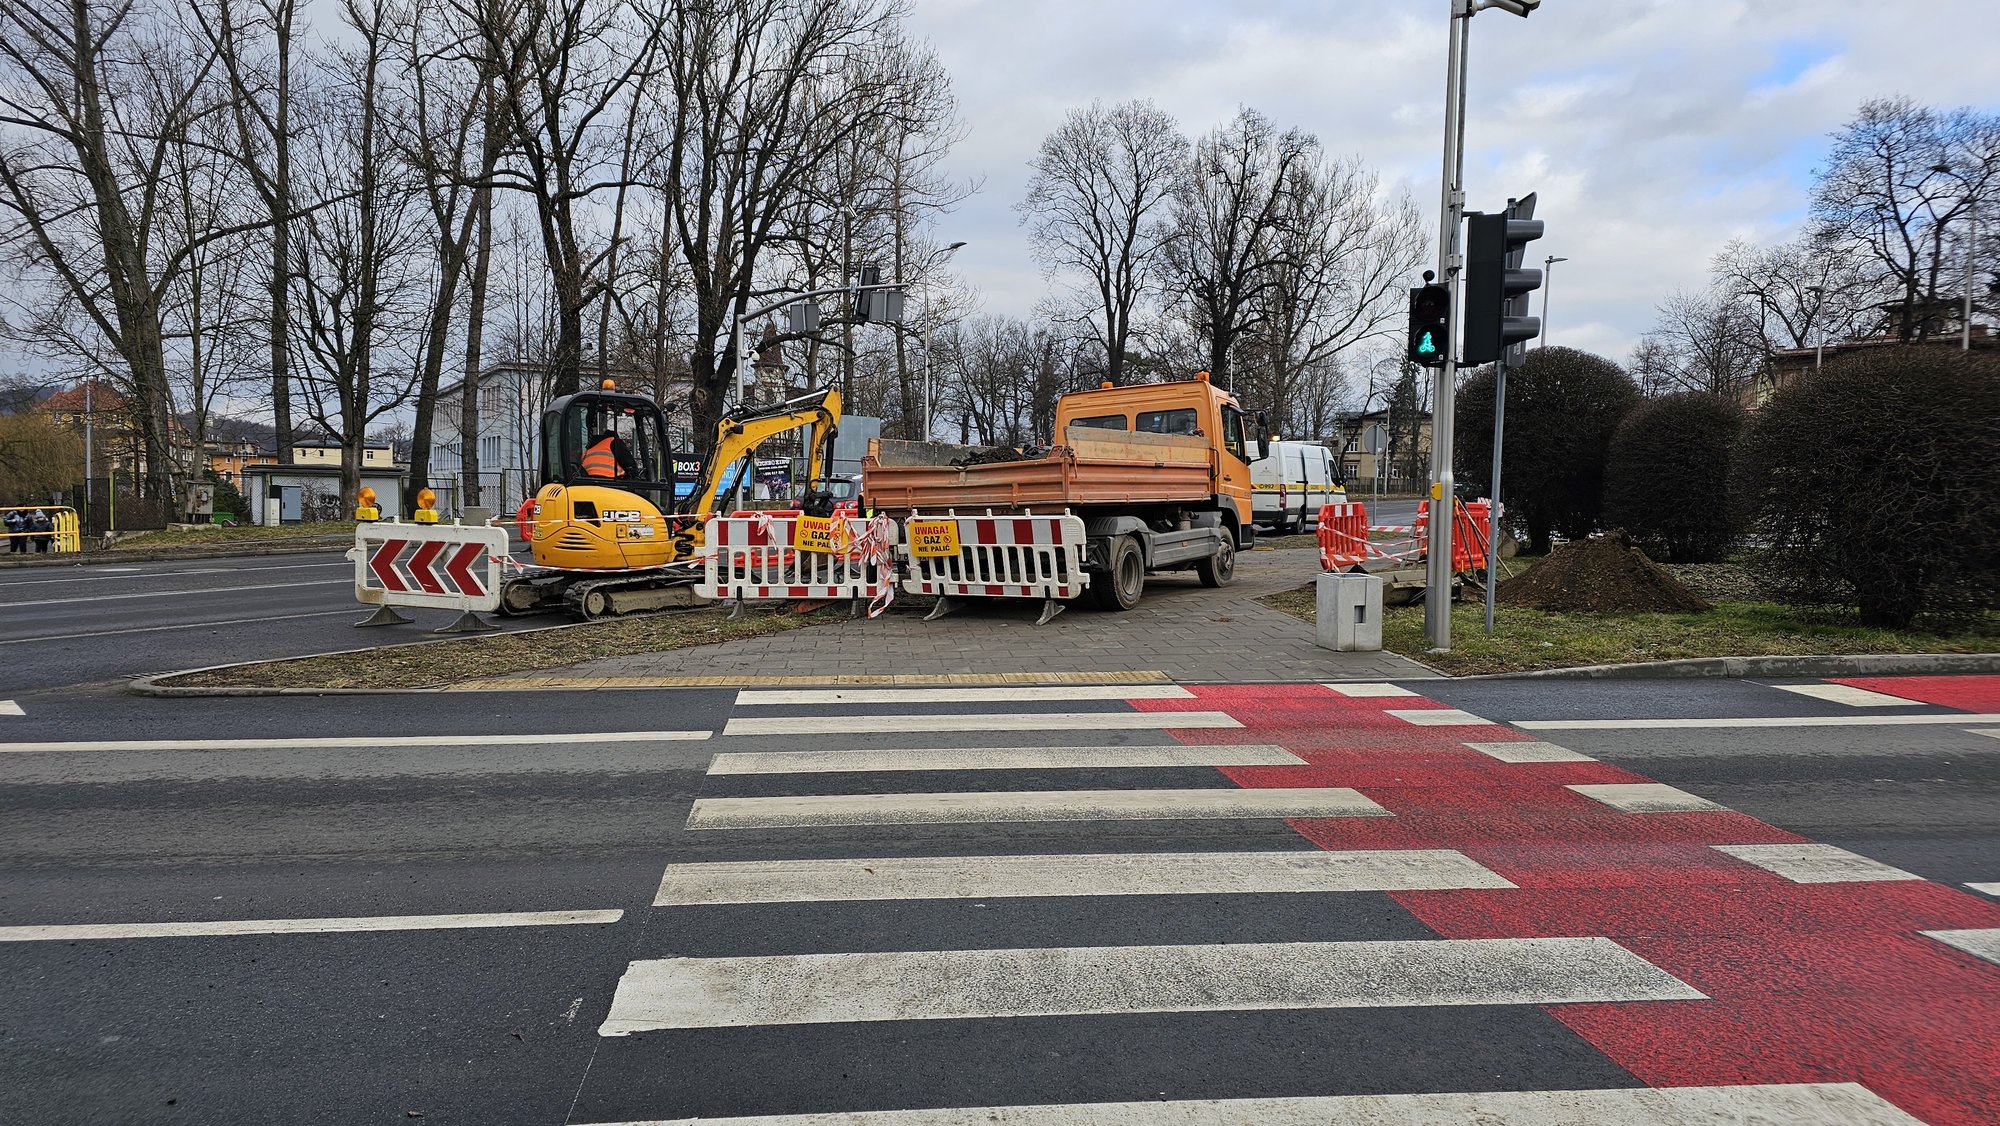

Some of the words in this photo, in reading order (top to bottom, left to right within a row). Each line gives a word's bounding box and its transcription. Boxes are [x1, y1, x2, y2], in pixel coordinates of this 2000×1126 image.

[677, 461, 701, 472] BOX3
[602, 510, 641, 522] JCB
[803, 520, 840, 531] UWAG!
[914, 525, 949, 535] UWAGA!
[811, 530, 831, 540] GAZ
[923, 535, 941, 544] GAZ
[930, 544, 950, 552] PALIĆ
